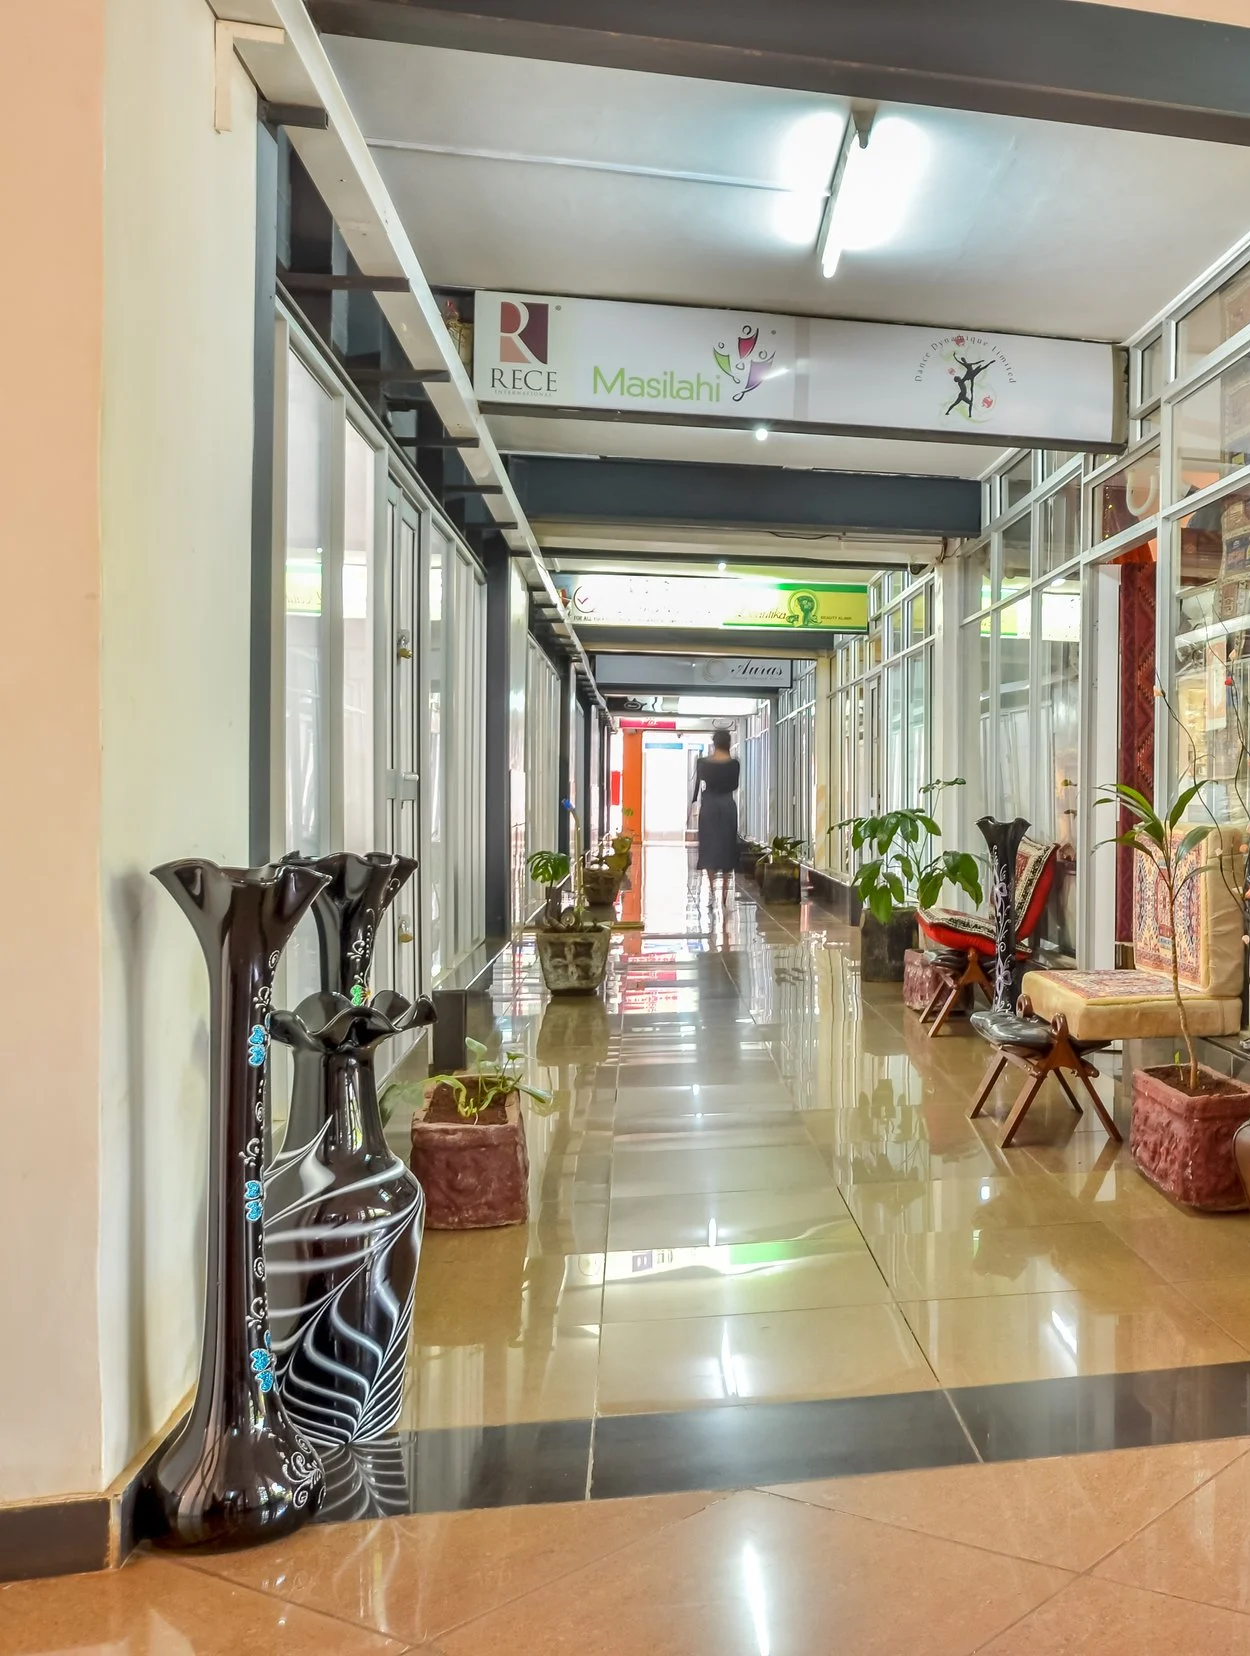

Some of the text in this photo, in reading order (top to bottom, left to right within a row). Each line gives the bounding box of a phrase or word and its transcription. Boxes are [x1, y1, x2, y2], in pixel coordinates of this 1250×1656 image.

[491, 368, 558, 392] RECE
[914, 352, 930, 382] Dance
[991, 345, 1016, 384] Limited
[593, 365, 721, 402] Masilahi
